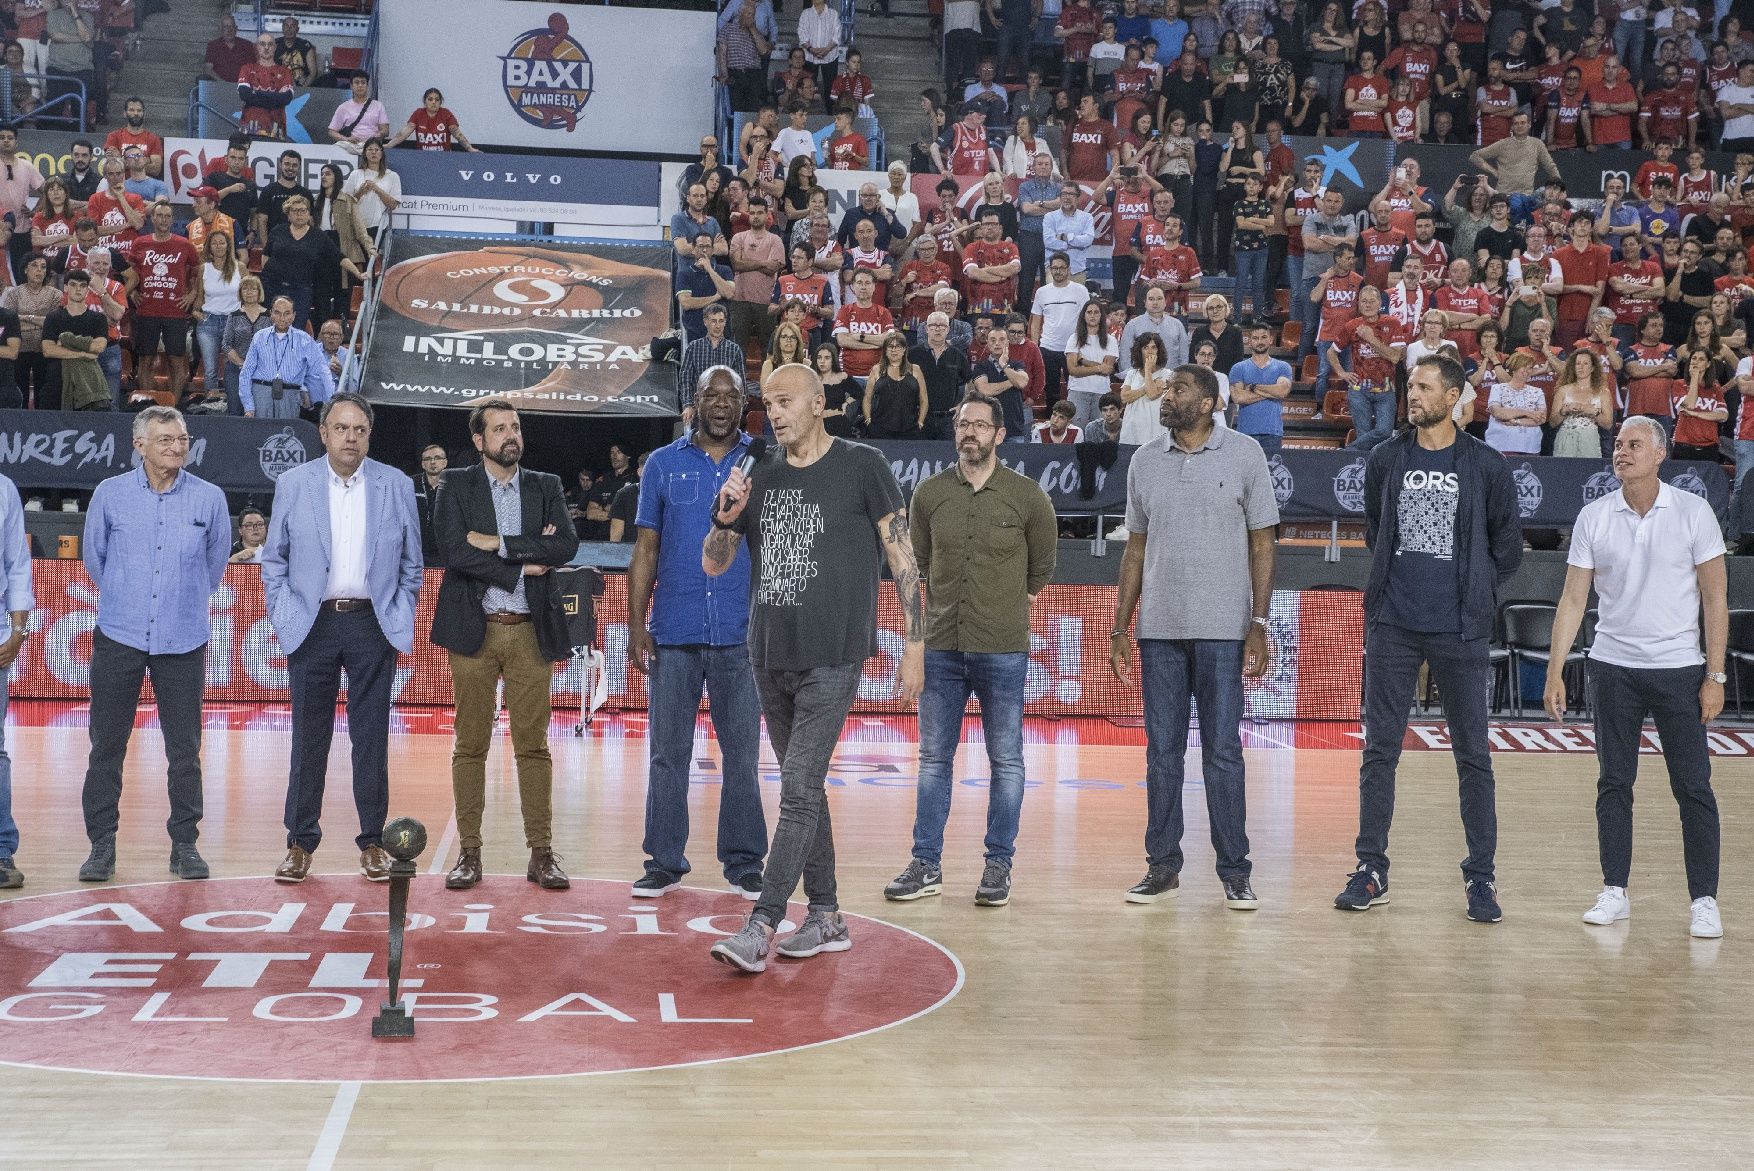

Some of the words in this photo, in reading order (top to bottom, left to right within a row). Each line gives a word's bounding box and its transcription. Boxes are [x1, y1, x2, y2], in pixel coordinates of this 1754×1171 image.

[506, 58, 591, 90] BAXI
[1406, 63, 1429, 73] BAXI
[521, 93, 577, 108] MANRESA
[417, 133, 446, 144] BAXI
[1070, 132, 1101, 144] BAXI
[458, 170, 561, 184] VOLVO
[420, 202, 468, 215] Premium
[1117, 204, 1149, 214] BAXI
[446, 265, 613, 287] CONSTRUCCIONS
[410, 298, 522, 316] SALIDO
[533, 306, 643, 318] CARRIÓ
[850, 321, 882, 335] BAXI
[402, 335, 642, 363] INLLOBSA
[380, 381, 659, 403] www.grupsalido.com
[262, 453, 306, 468] BAXI
[1, 902, 798, 935] Adbisio
[26, 952, 424, 988] ETL
[0, 991, 754, 1022] GLOBAL
